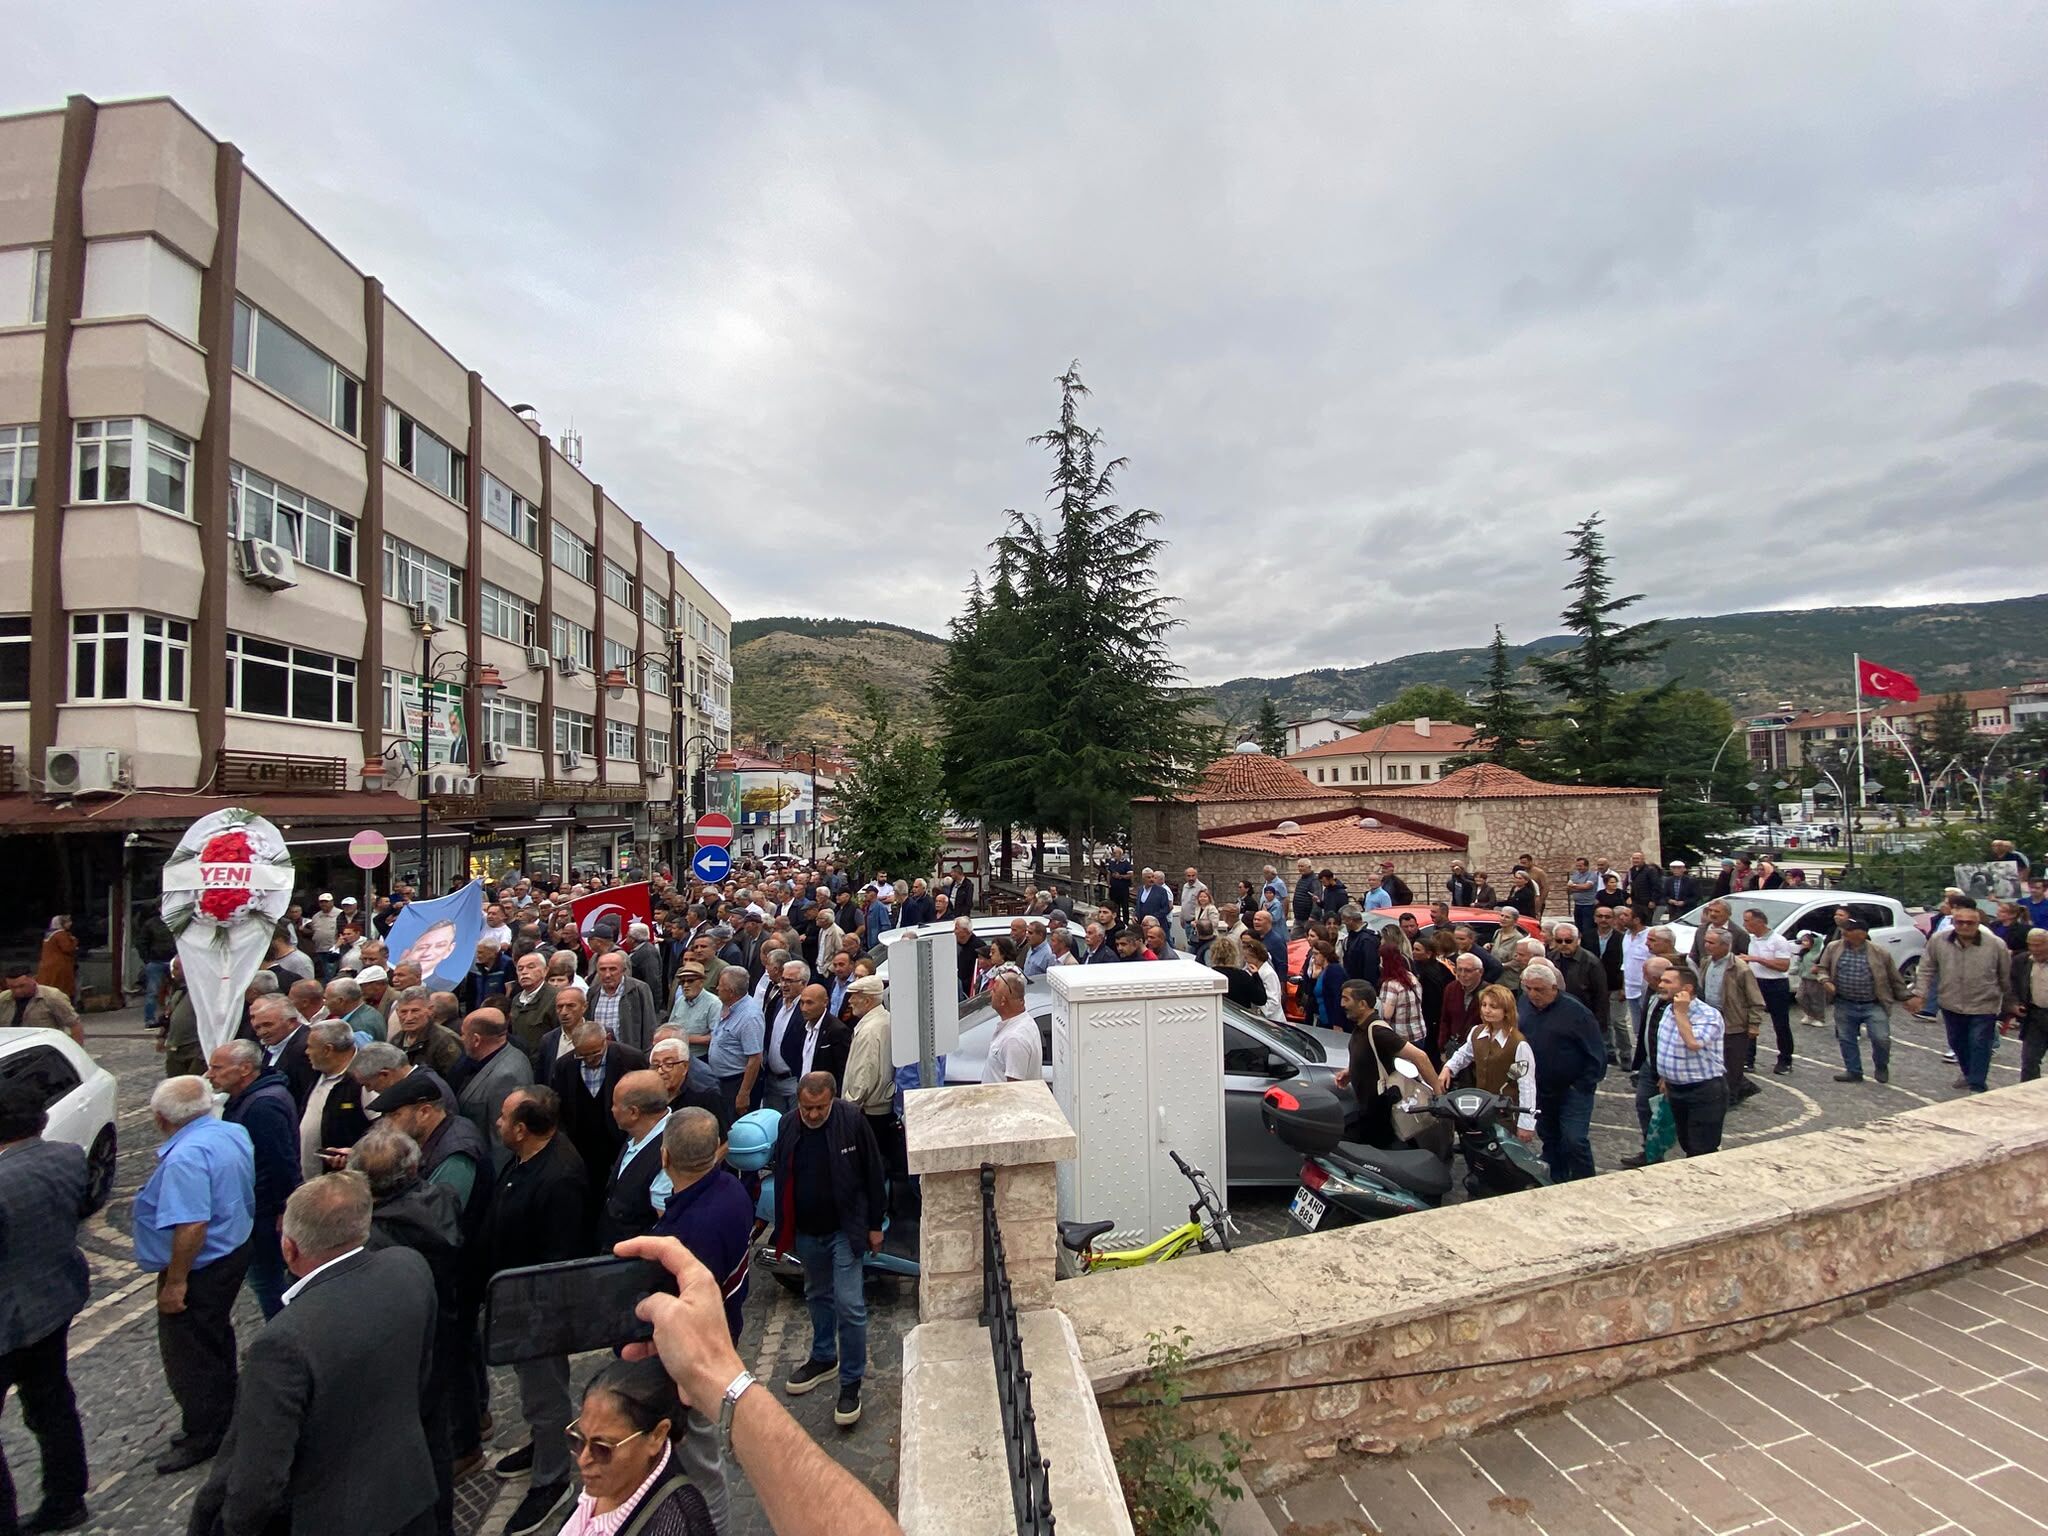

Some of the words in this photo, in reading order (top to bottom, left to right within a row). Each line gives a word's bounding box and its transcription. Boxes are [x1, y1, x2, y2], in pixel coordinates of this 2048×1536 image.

[1298, 1189, 1308, 1202] 60
[1308, 1197, 1323, 1215] AHD
[1299, 1206, 1313, 1224] 889
